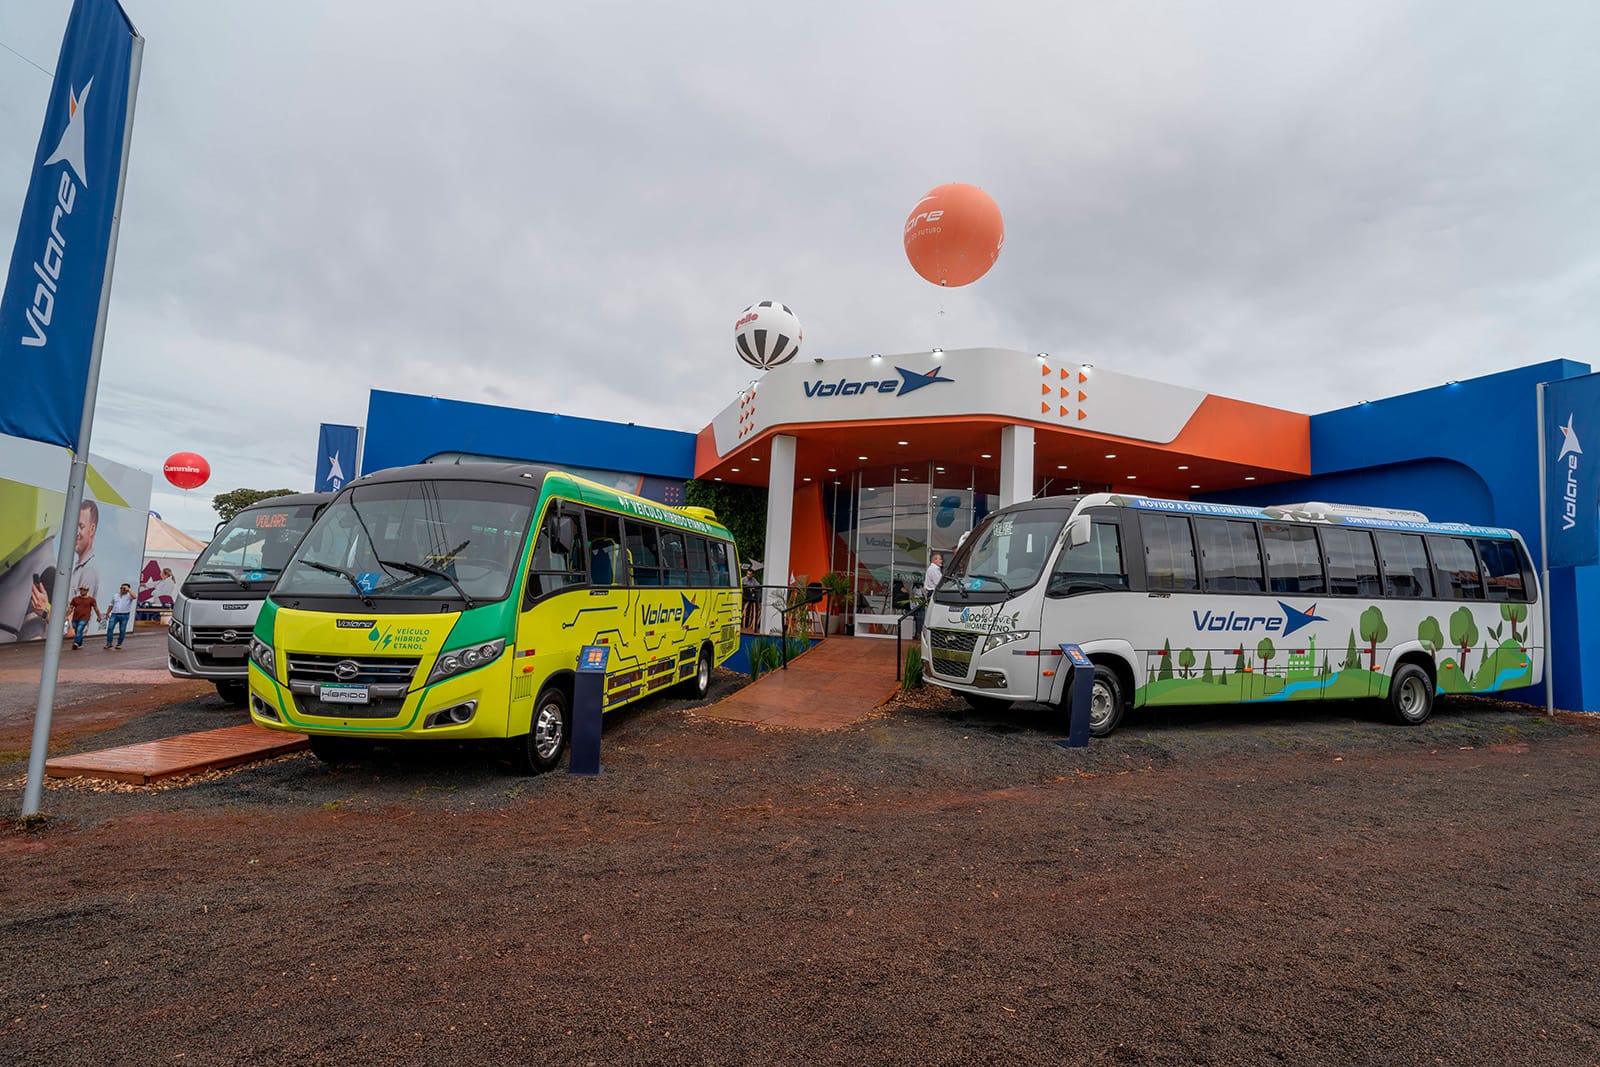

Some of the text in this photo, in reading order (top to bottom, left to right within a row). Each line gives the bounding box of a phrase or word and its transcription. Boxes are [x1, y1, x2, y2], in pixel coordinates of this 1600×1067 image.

[904, 210, 944, 233] are
[21, 171, 76, 347] Volare
[803, 379, 899, 398] Volare
[164, 464, 200, 473] Cummins
[1562, 454, 1578, 531] Volare
[1138, 500, 1175, 509] MOVIDO
[1210, 506, 1259, 516] BIOMETANO
[255, 513, 289, 528] VOLARE
[337, 620, 373, 628] Volare
[641, 603, 682, 626] Volare
[1193, 610, 1283, 631] Volare
